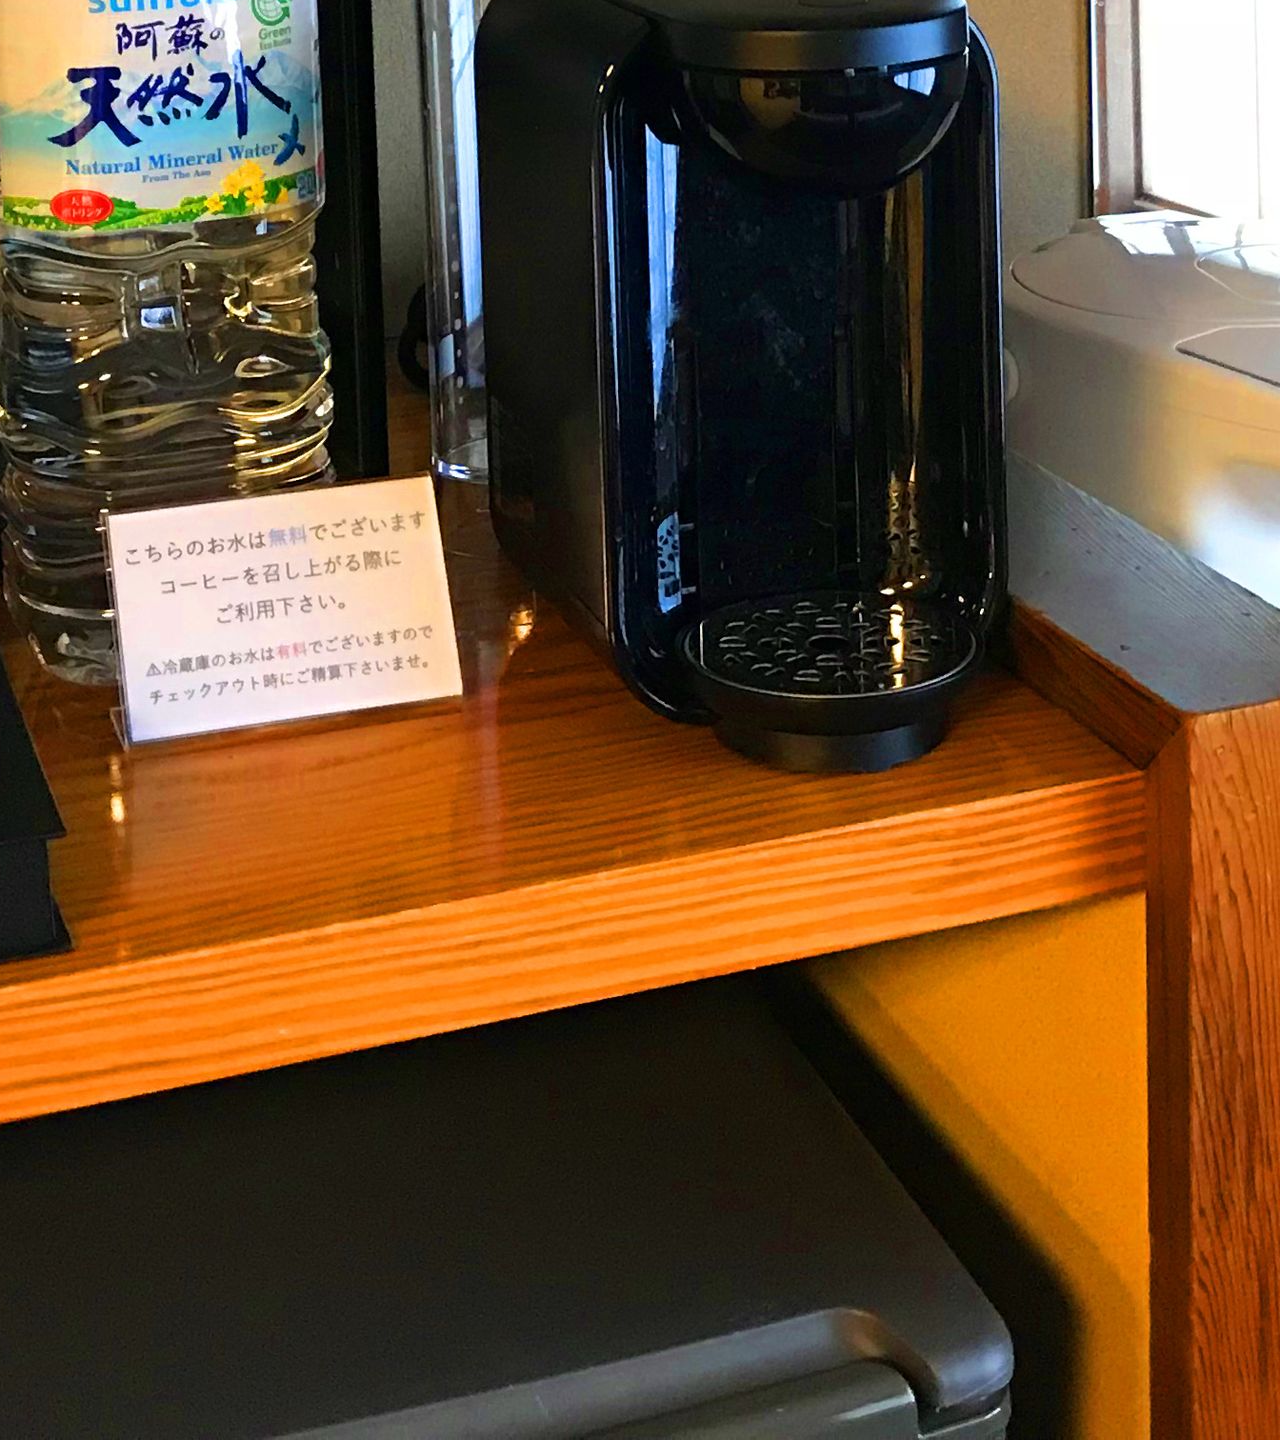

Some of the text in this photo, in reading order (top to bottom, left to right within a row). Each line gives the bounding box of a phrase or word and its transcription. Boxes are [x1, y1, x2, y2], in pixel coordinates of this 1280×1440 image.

[116, 14, 225, 61] 阿蘇の
[258, 25, 291, 40] Green
[47, 55, 292, 148] 天然水
[65, 141, 279, 176] Natural Mineral Water
[172, 170, 191, 180] The
[125, 511, 426, 566] こちらのお水は無料でございます
[160, 547, 403, 595] コーヒーを召し上がる際に
[216, 594, 348, 625] ご利用下さい。
[149, 654, 429, 705] チェックアウト時にご精算下さいませ。
